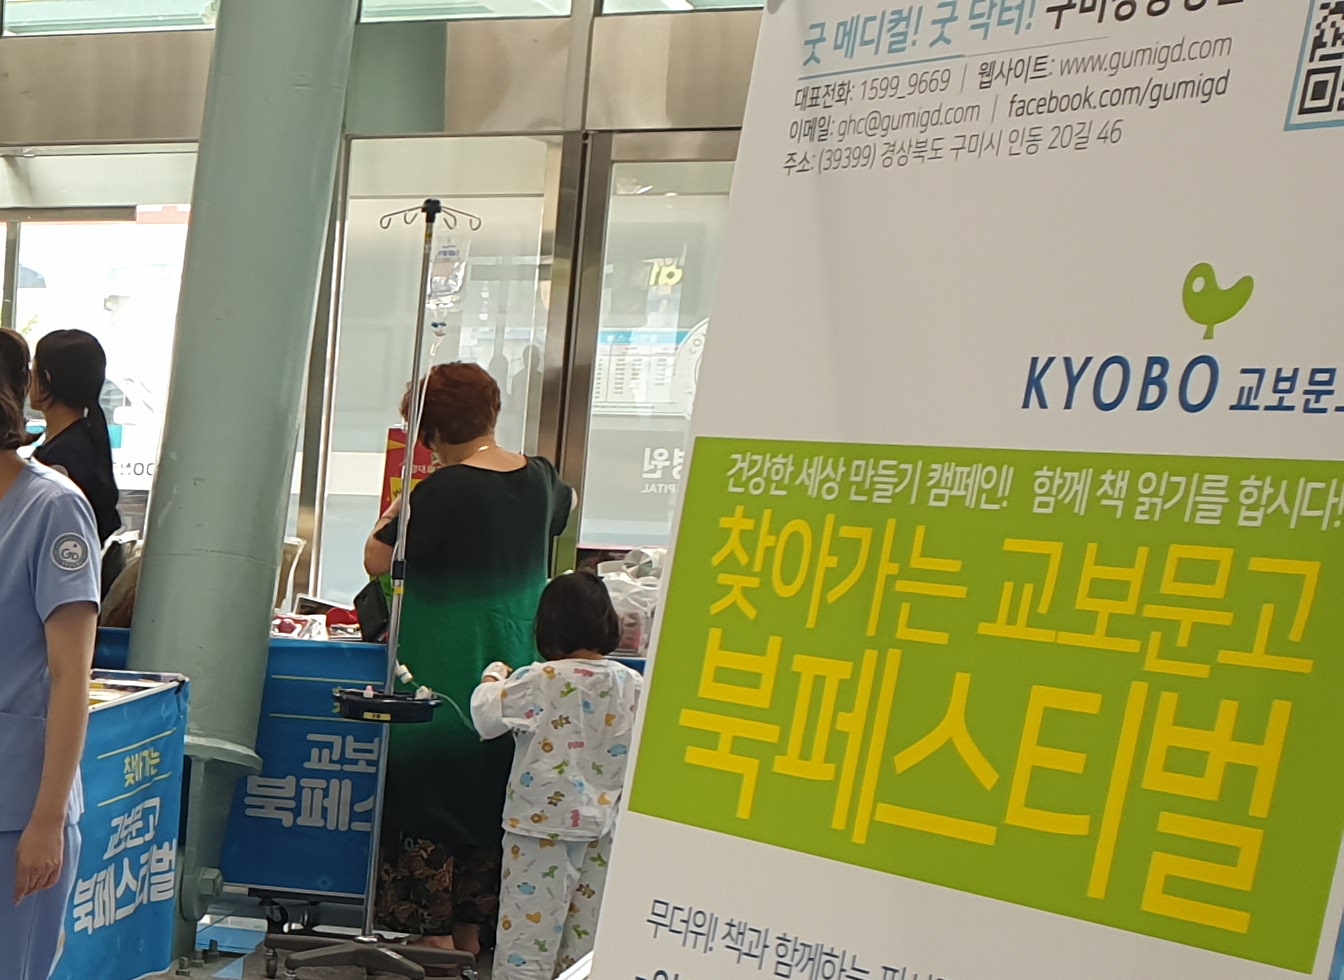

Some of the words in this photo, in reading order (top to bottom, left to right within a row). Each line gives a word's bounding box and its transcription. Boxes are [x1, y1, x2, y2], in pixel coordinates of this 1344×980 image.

[803, 22, 826, 66] 굿
[833, 6, 923, 58] 메디컬!
[929, 2, 960, 48] 굿
[968, 0, 1036, 40] 닥터!
[789, 115, 836, 144] 이메일:
[837, 102, 981, 143] ghc@gumigd.com
[1007, 68, 1231, 117] facebook.com/gumigd
[794, 79, 856, 112] 대표전화:
[860, 68, 951, 102] 1599_9669
[978, 55, 1056, 90] 웹사이트:
[1060, 36, 1233, 77] www.gumigd.com
[783, 152, 816, 176] 주소:
[818, 142, 876, 174] (39399)
[880, 135, 946, 168] 경상북도
[949, 129, 1004, 162] 구미시
[1008, 126, 1044, 156] 인동
[1047, 119, 1093, 150] 20길
[1096, 118, 1124, 144] 46
[1021, 354, 1220, 413] KYOBO
[1228, 366, 1344, 414] 교보문
[726, 452, 795, 497] 건강한
[795, 456, 846, 500] 세상
[849, 458, 923, 504] 만들기
[1031, 465, 1094, 516] 함께
[1096, 469, 1131, 519] 책
[1134, 471, 1230, 525] 읽기를
[710, 504, 968, 645] 찾아가는
[977, 538, 1322, 678] 교보문고
[679, 628, 1293, 934] 북페스티벌
[646, 899, 720, 954] 무더위!
[721, 918, 770, 971] 책과
